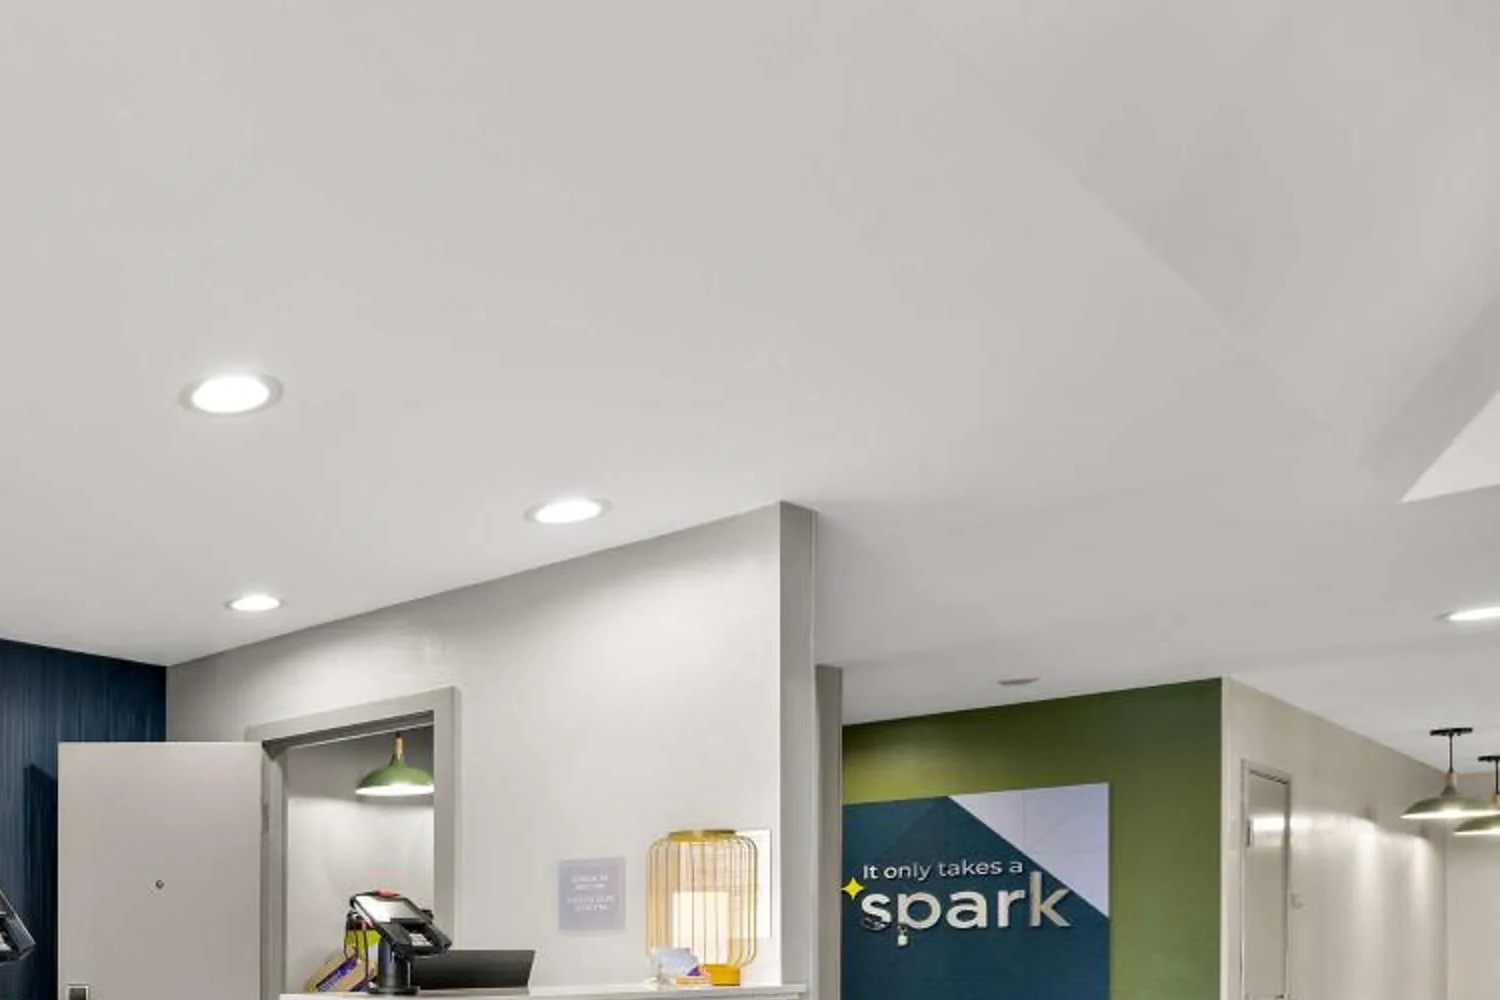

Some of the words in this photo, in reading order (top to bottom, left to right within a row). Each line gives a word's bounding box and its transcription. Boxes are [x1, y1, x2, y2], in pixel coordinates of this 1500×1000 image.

[863, 865, 879, 879] It
[884, 862, 931, 881] only
[938, 859, 1002, 877] takes
[1009, 861, 1023, 873] a
[860, 871, 1071, 946] spark
